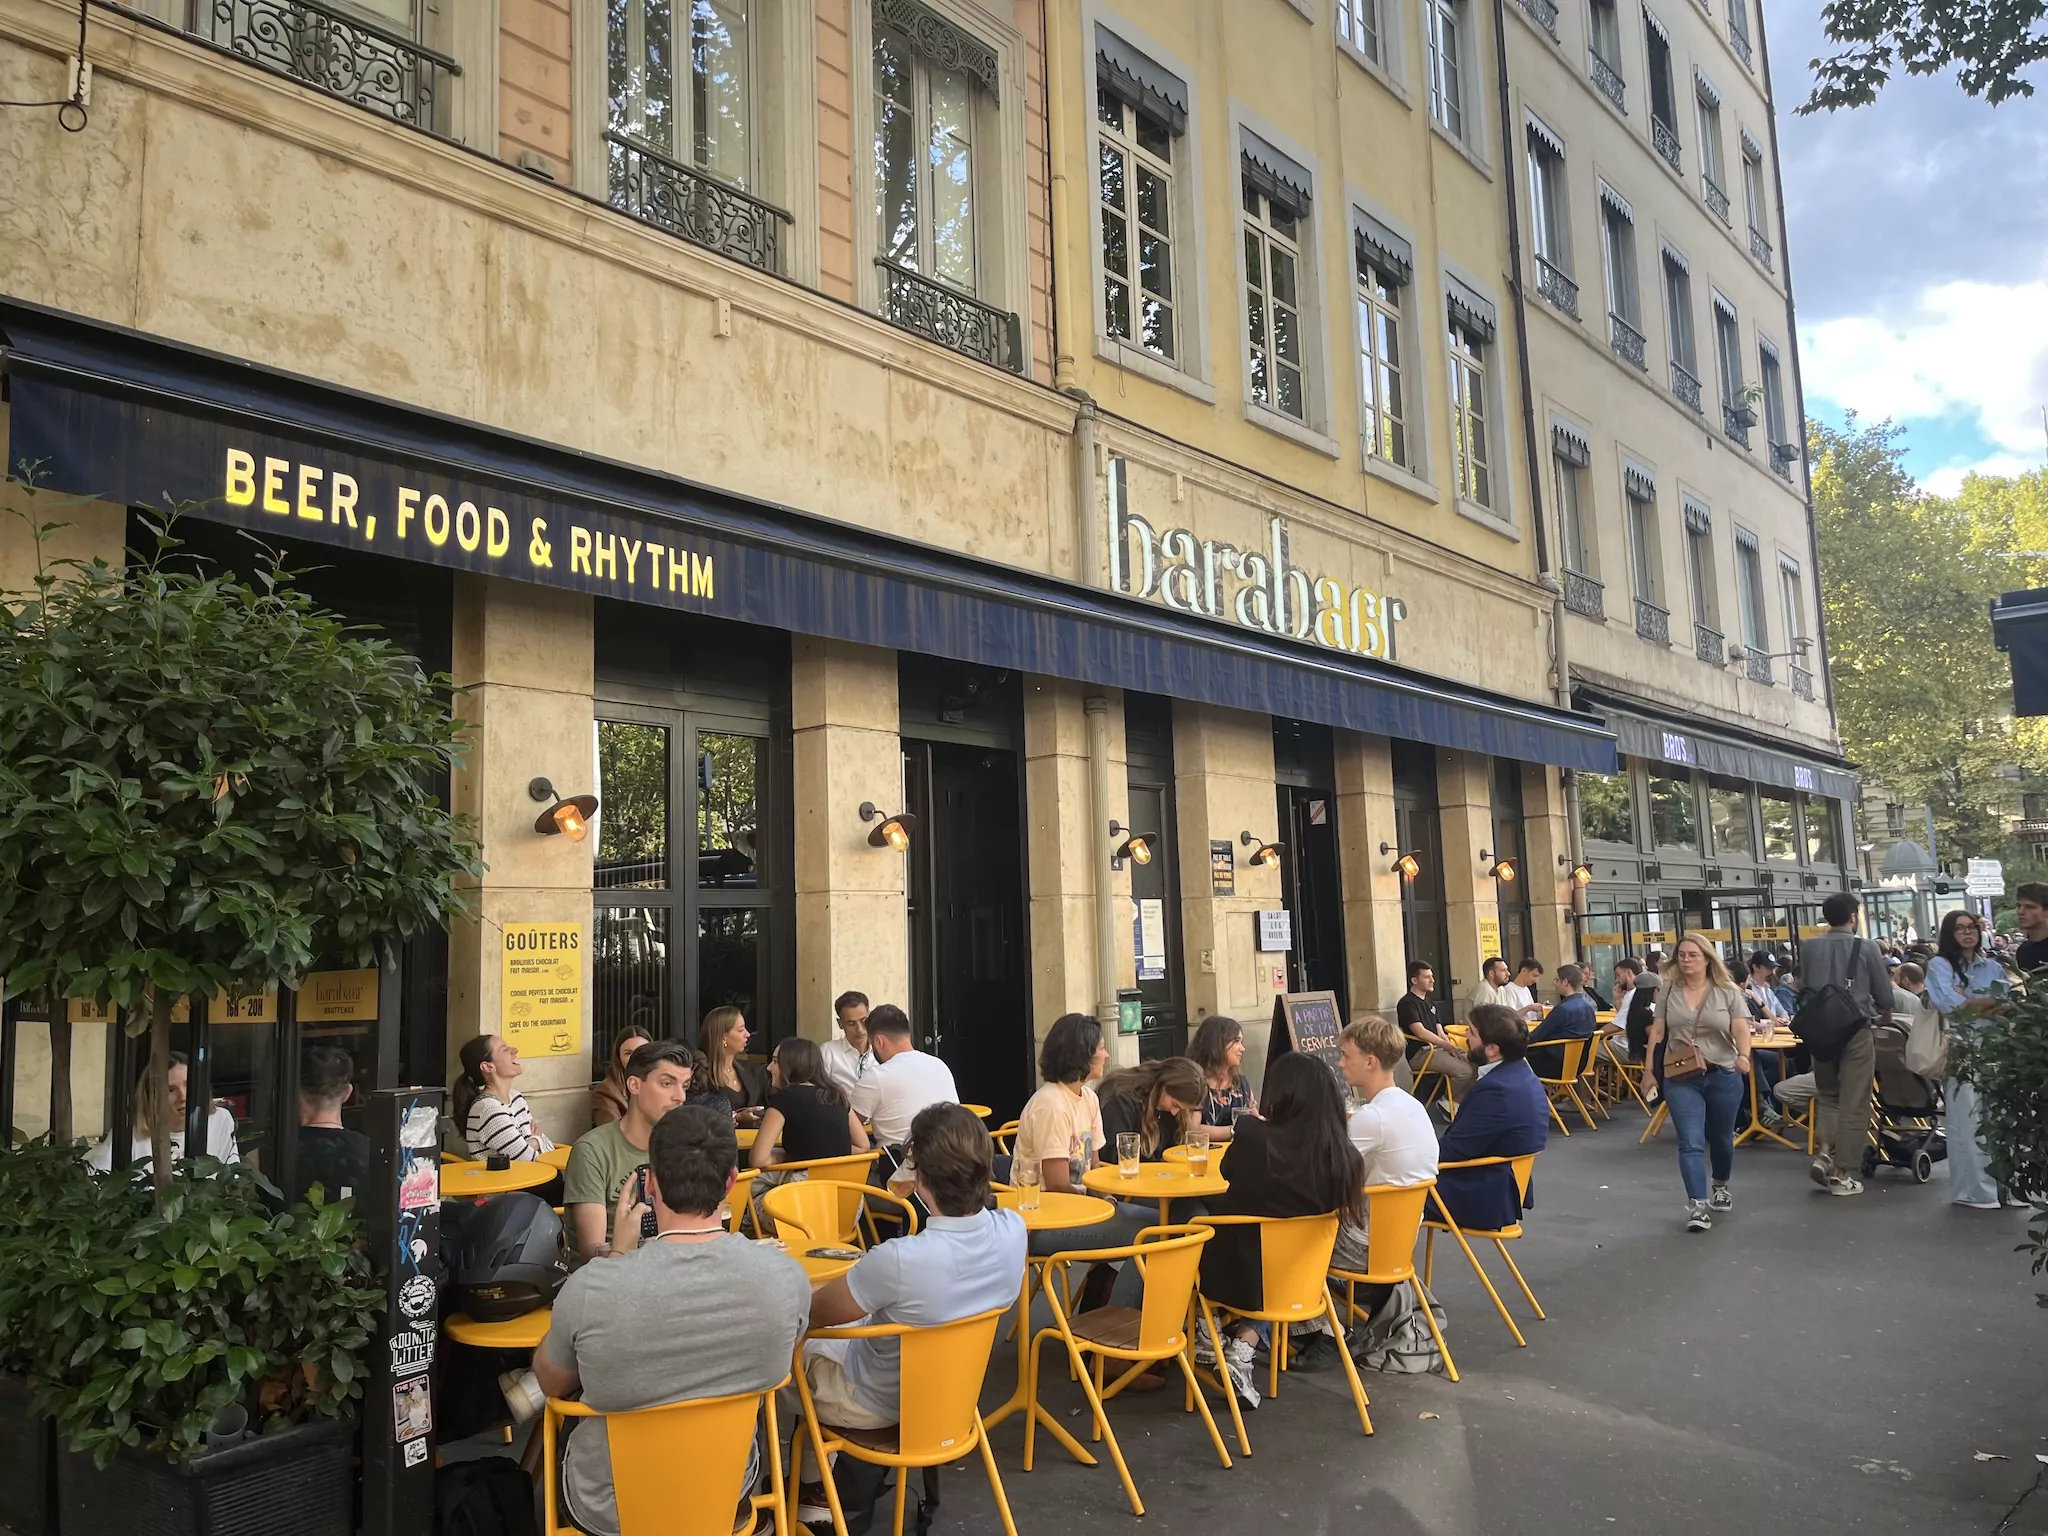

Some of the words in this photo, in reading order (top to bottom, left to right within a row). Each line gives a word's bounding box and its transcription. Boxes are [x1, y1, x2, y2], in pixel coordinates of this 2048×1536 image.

[226, 448, 377, 540] BEER,
[397, 487, 510, 557] FOOD
[529, 516, 553, 567] &
[570, 526, 714, 599] RHYTHM
[1113, 858, 1119, 868] 4
[506, 928, 578, 950] GOÛTERS
[548, 988, 554, 996] DE
[248, 998, 263, 1017] 20H
[323, 1006, 355, 1015] BROTTEAUX
[1303, 1007, 1332, 1022] PARTIR
[522, 1020, 529, 1028] OU
[1304, 1023, 1317, 1035] DE
[1301, 1035, 1337, 1053] SERVICE
